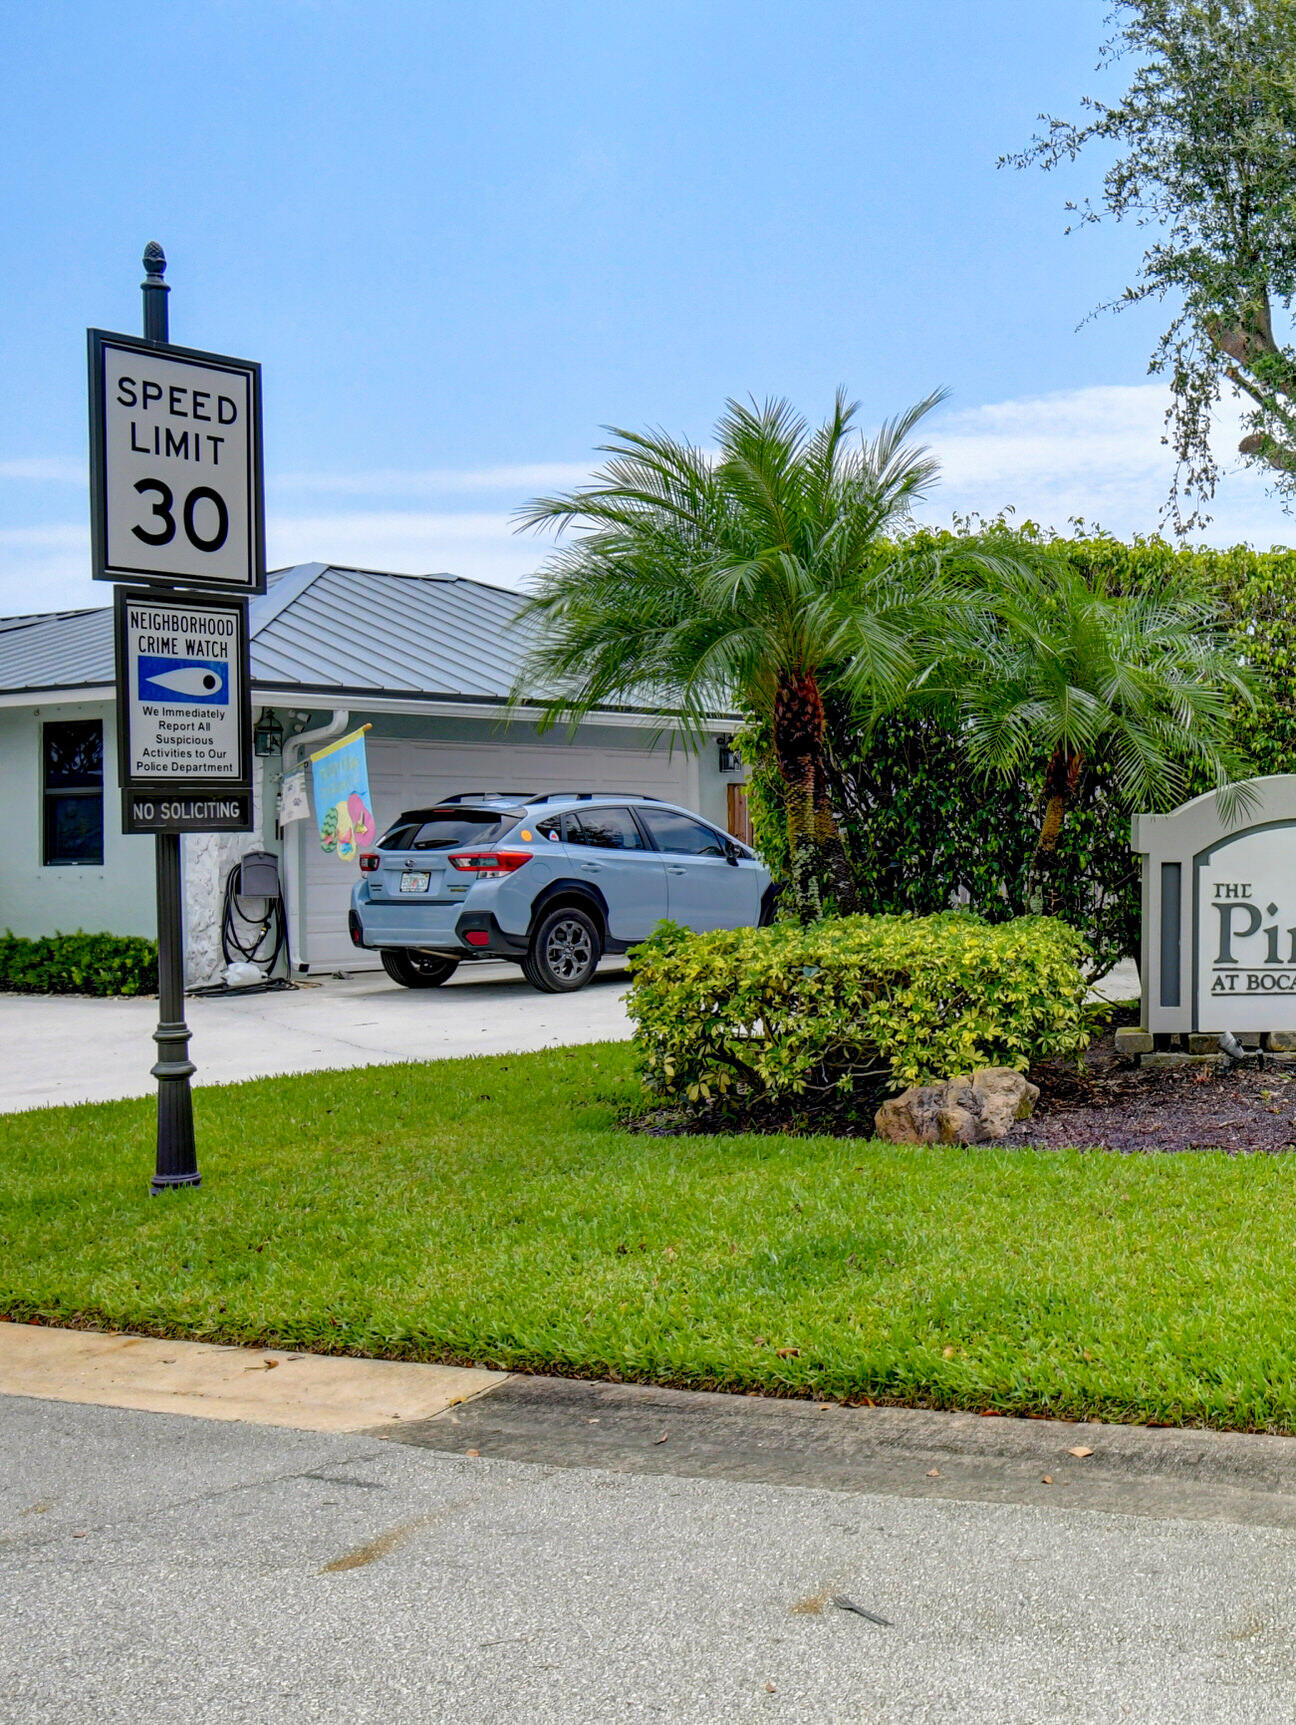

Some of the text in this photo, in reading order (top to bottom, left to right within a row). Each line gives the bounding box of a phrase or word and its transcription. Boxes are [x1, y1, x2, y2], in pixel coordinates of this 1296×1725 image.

[116, 376, 238, 425] SPEED
[130, 421, 225, 465] LIMIT
[130, 477, 229, 553] 30
[130, 611, 234, 637] NEIGHBORHOOD
[138, 635, 228, 659] CRIME WATCH
[143, 706, 225, 721] We Immediately
[159, 721, 211, 733] Report All
[155, 734, 214, 747] Suspicious
[142, 748, 227, 759] Activities to Our
[136, 762, 233, 775] Police Department
[133, 801, 241, 820] NO SOLICITING
[1211, 974, 1239, 991] AT
